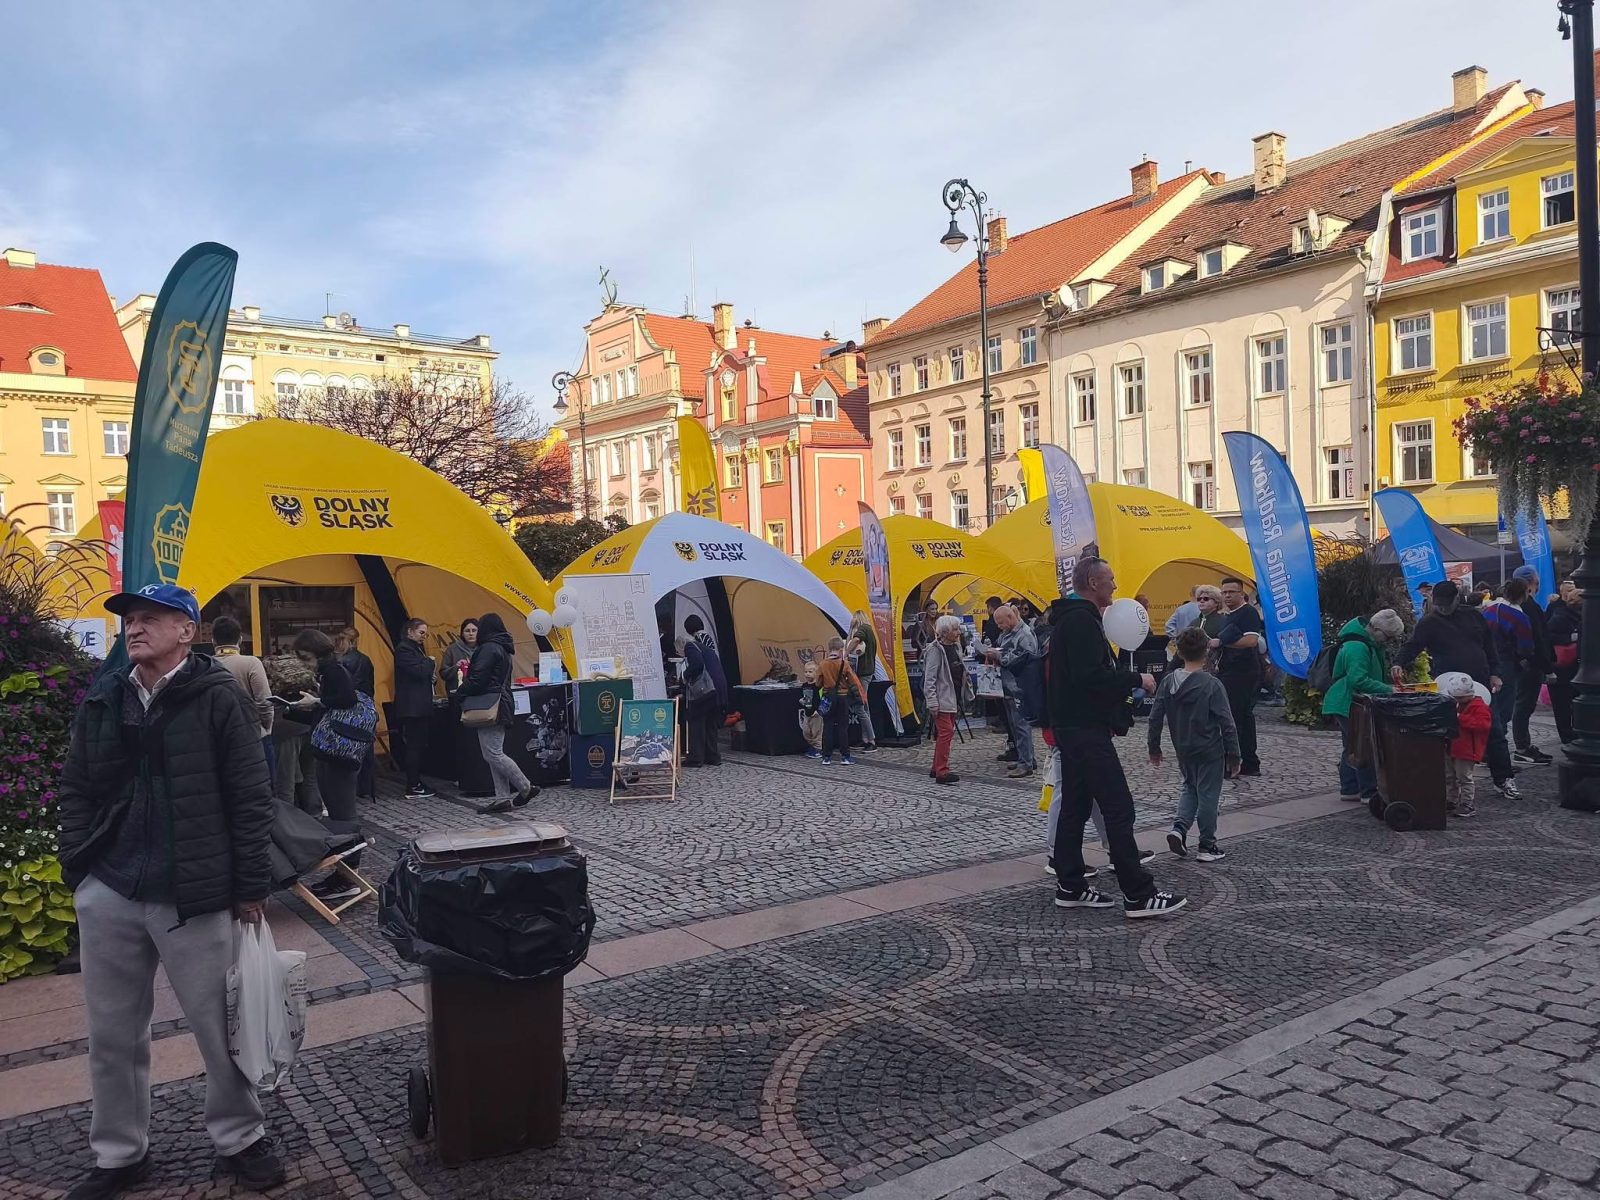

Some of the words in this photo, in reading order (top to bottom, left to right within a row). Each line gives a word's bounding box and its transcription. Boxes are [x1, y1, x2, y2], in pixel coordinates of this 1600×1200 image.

[168, 416, 199, 439] Muzeum
[174, 431, 193, 447] Pana
[164, 440, 199, 463] Tadeusza
[313, 496, 390, 512] DOLNY
[319, 510, 394, 531] ŚLĄSK
[699, 542, 743, 552] DOLNY
[846, 549, 864, 558] DOL
[927, 541, 962, 551] DOLNY
[703, 550, 748, 562] ŚLĄSK
